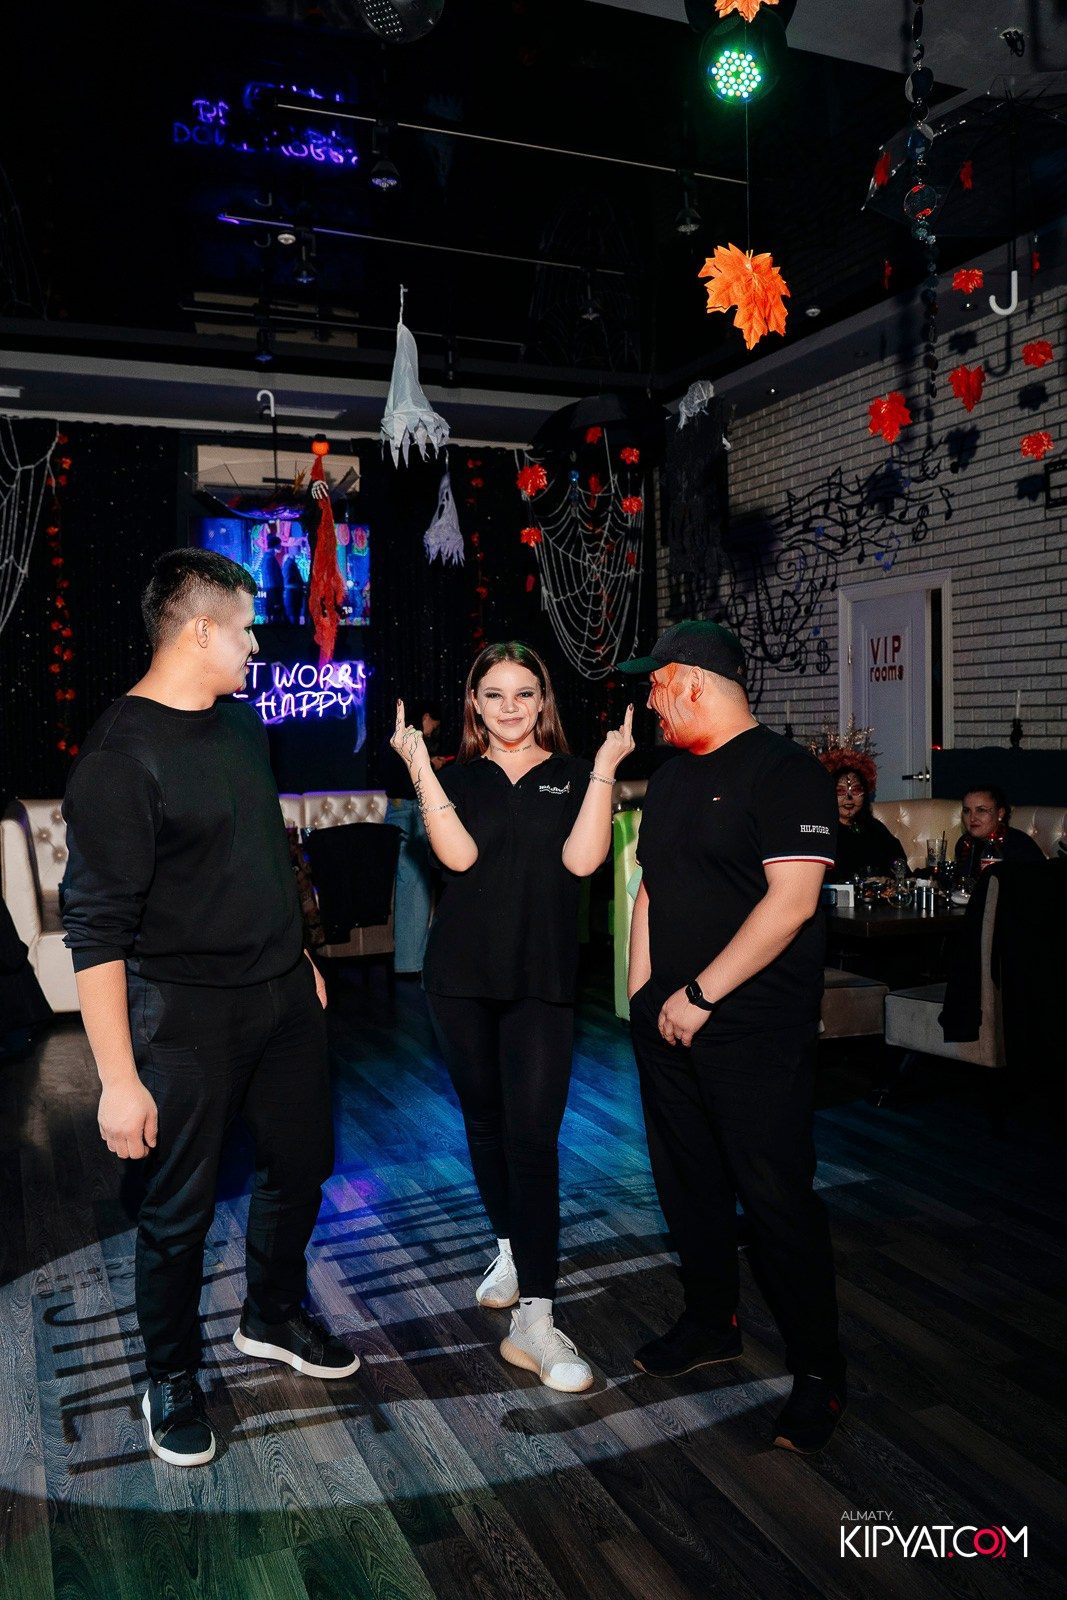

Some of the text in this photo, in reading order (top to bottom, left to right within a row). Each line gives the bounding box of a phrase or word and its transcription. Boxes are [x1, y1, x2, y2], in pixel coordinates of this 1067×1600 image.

[870, 635, 901, 665] VIP
[870, 665, 904, 682] rooms
[256, 691, 354, 720] HAPPY
